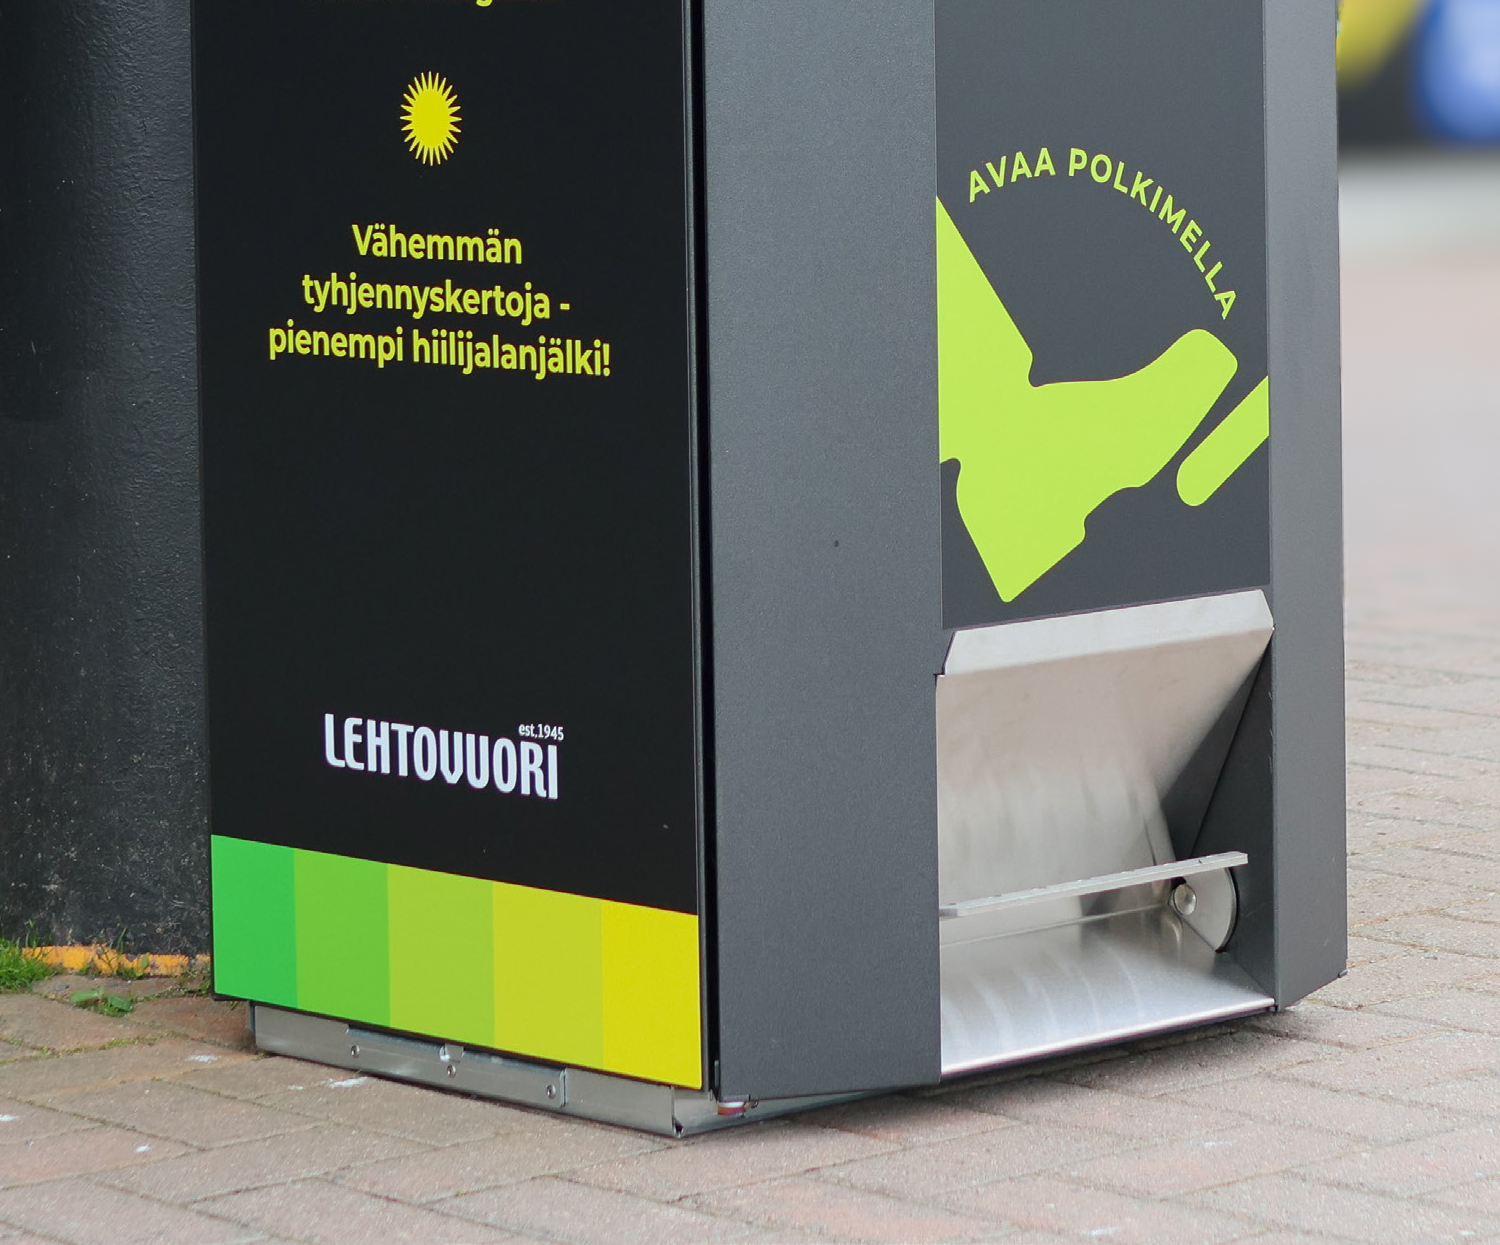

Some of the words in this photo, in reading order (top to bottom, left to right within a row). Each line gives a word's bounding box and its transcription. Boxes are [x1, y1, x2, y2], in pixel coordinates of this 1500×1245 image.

[351, 223, 522, 265] Vähemmän
[969, 147, 1056, 203] AVAA
[1068, 147, 1237, 320] POLKIMELLA
[302, 272, 551, 326] tyhjennyskertoja
[268, 319, 404, 369] pienempi
[412, 328, 611, 380] hiilijalanjälki!
[324, 712, 559, 800] LEHTOVUORI
